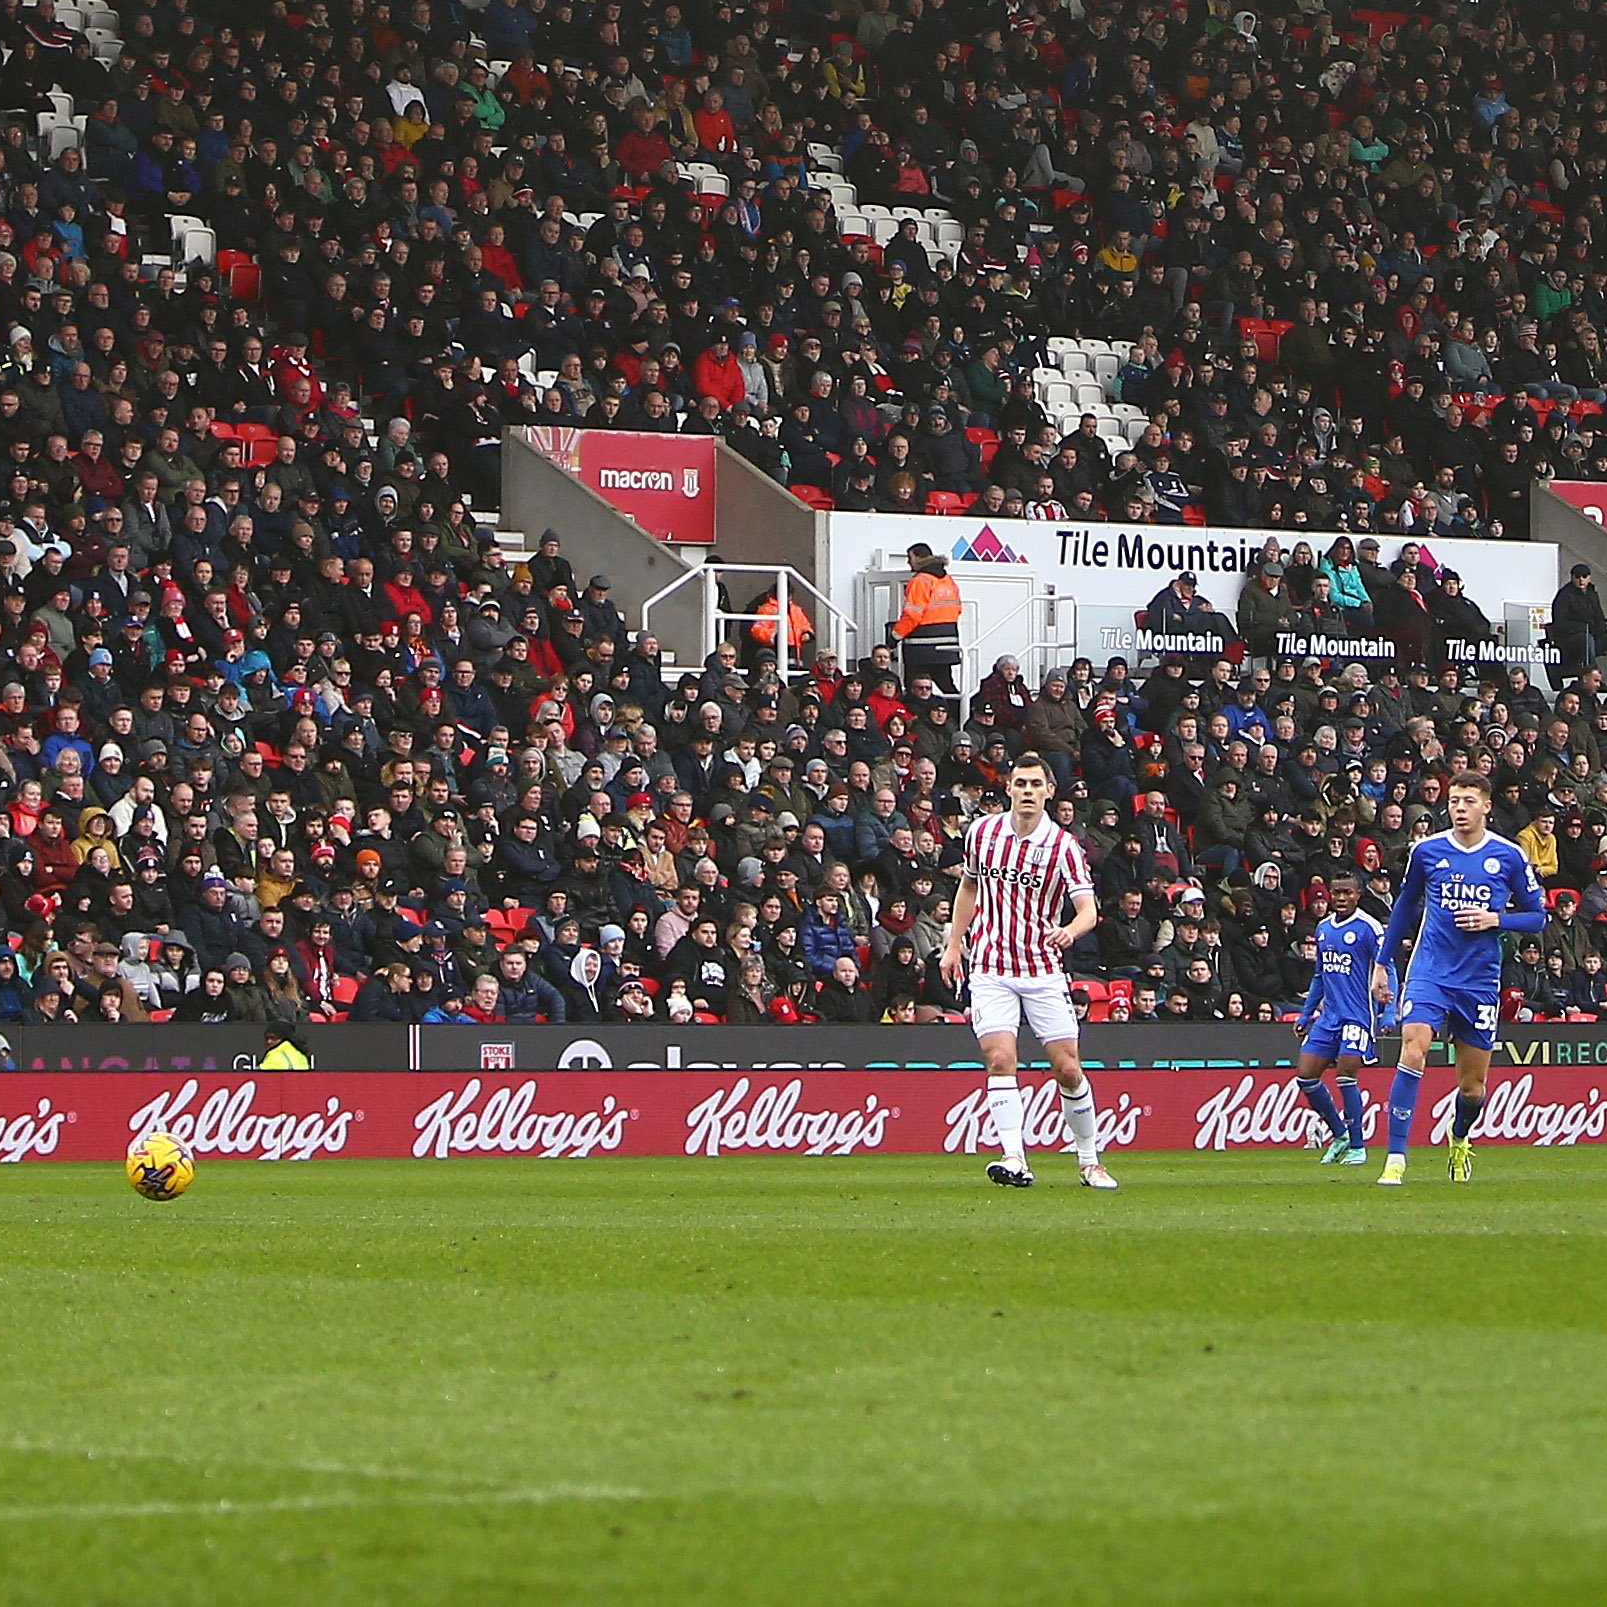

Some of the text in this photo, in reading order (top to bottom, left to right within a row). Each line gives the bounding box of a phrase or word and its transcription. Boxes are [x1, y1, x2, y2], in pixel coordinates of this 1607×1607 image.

[600, 469, 674, 491] macron
[1056, 530, 1110, 567] Tile
[1101, 627, 1224, 654] Tile Mountain
[1276, 633, 1395, 659] Tile Mountain
[1446, 639, 1561, 665] Tile Mountain
[980, 861, 1044, 889] bet365
[1440, 882, 1492, 901] KING
[1440, 898, 1491, 911] POWER
[1321, 951, 1352, 967] KING
[1322, 963, 1351, 976] POWER
[129, 1079, 353, 1161] Kellogg's
[413, 1077, 628, 1159] Kellogg's
[685, 1076, 890, 1157] Kellogg's
